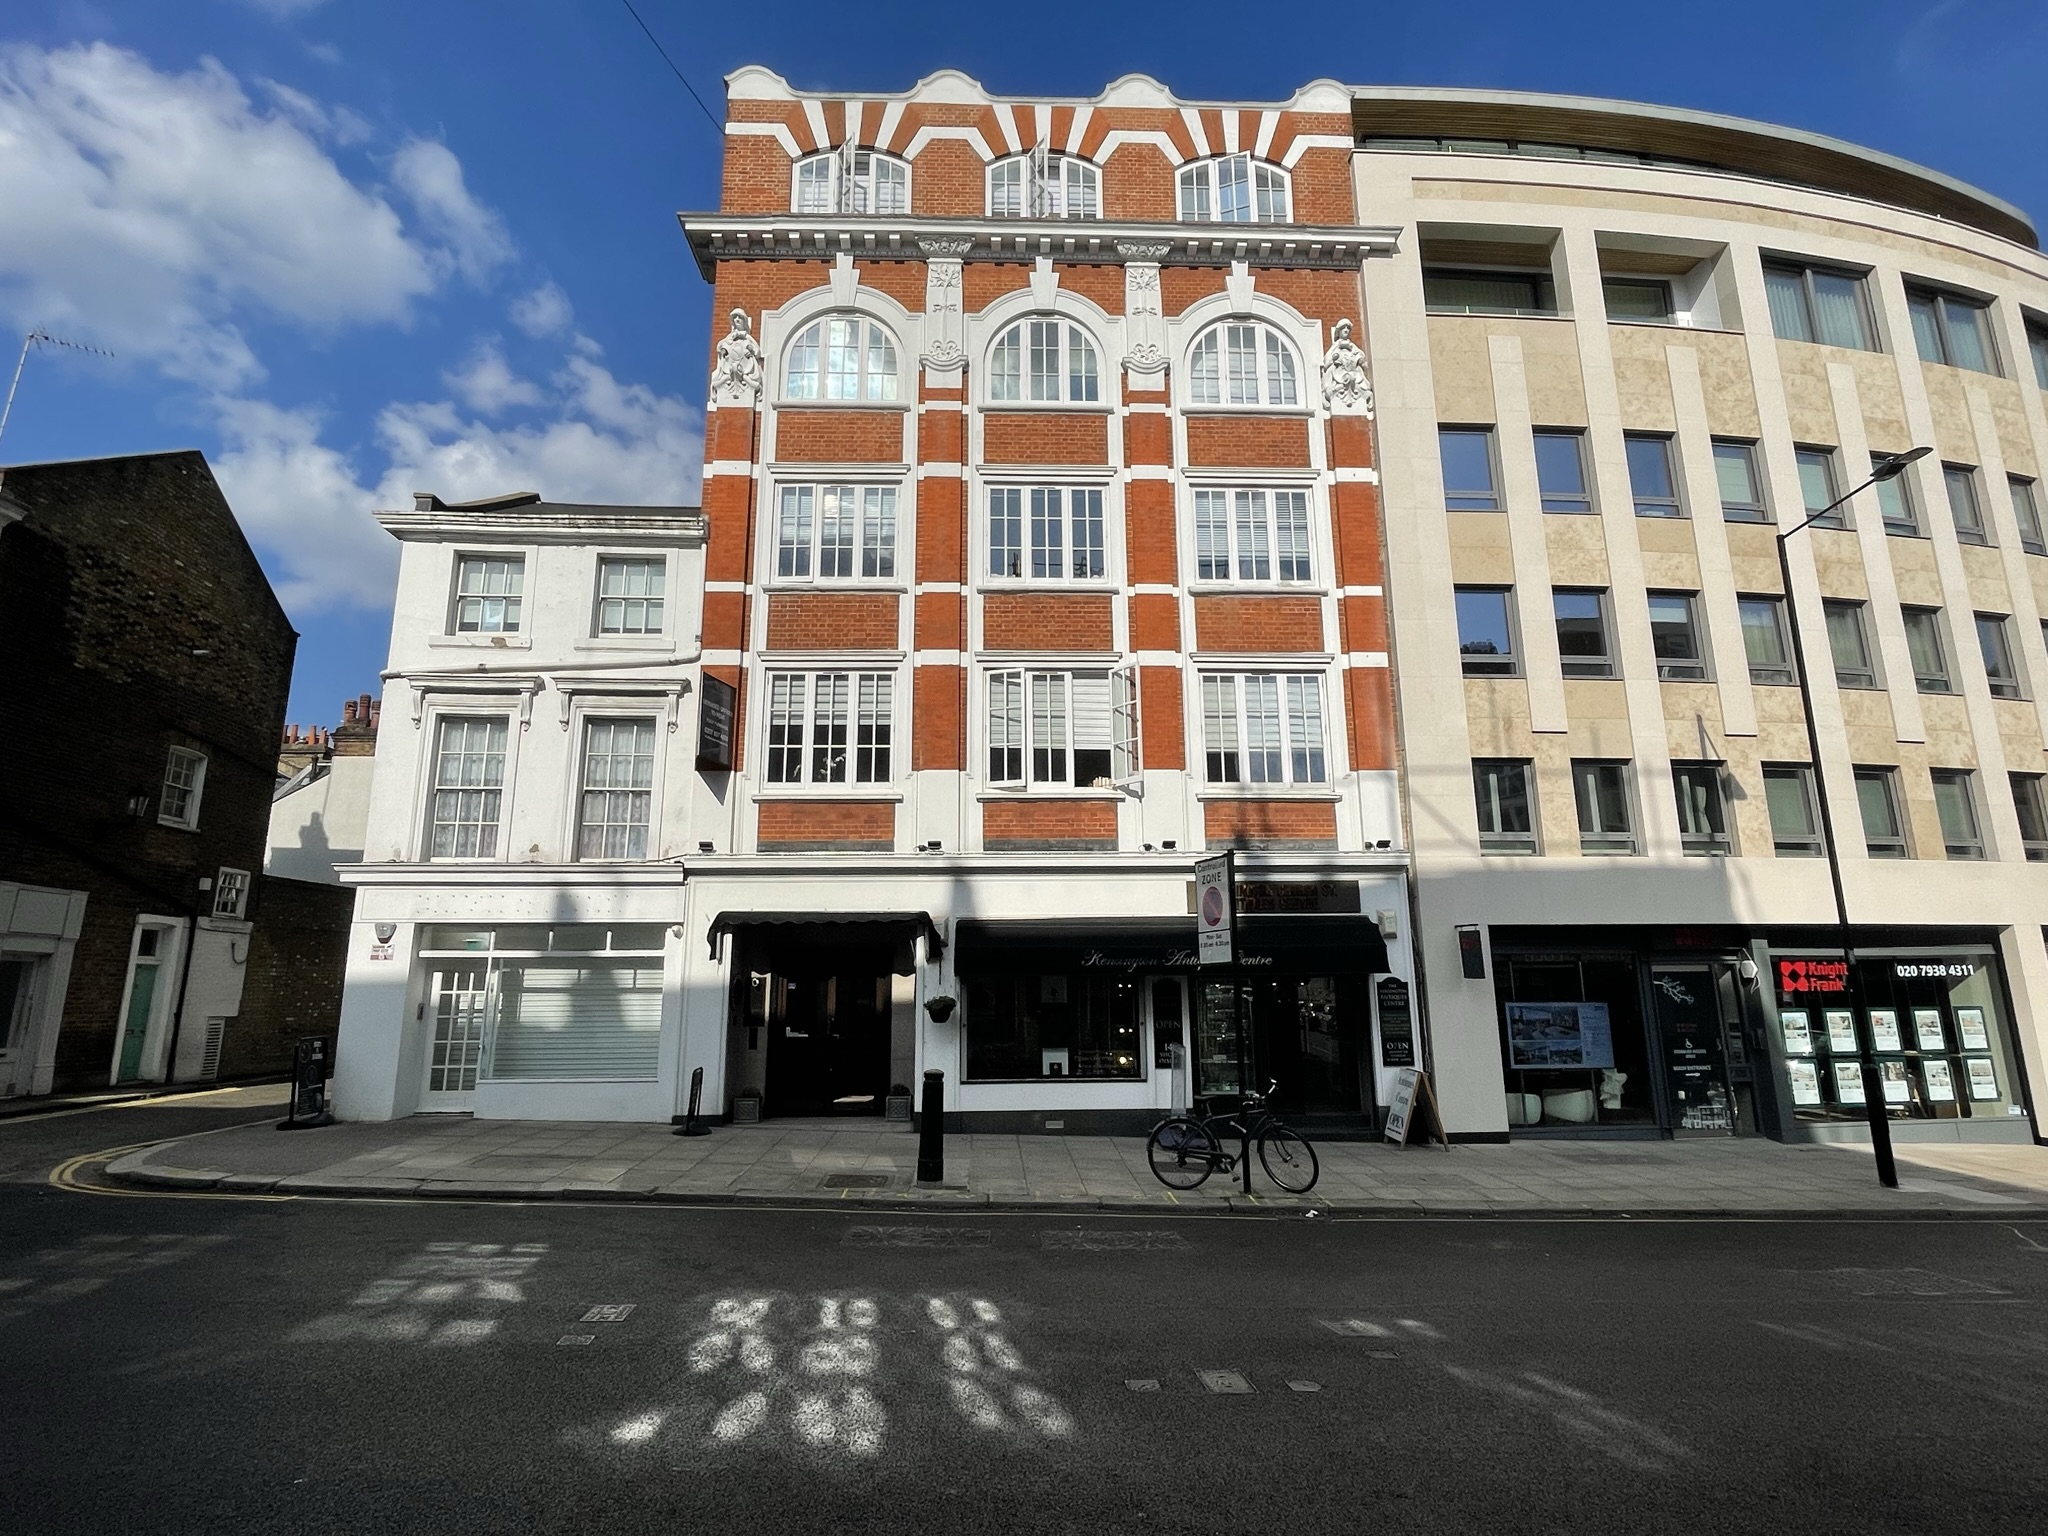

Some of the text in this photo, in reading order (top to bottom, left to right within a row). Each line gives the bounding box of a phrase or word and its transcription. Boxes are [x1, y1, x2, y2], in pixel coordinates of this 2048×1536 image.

[1197, 860, 1226, 873] Controlled
[1201, 872, 1222, 885] ZONE
[1162, 950, 1200, 971] Anti
[1808, 961, 1848, 979] Knight
[1897, 964, 1975, 977] 020 7938 4311
[1810, 978, 1845, 991] Frank
[1155, 1020, 1181, 1029] OPEN
